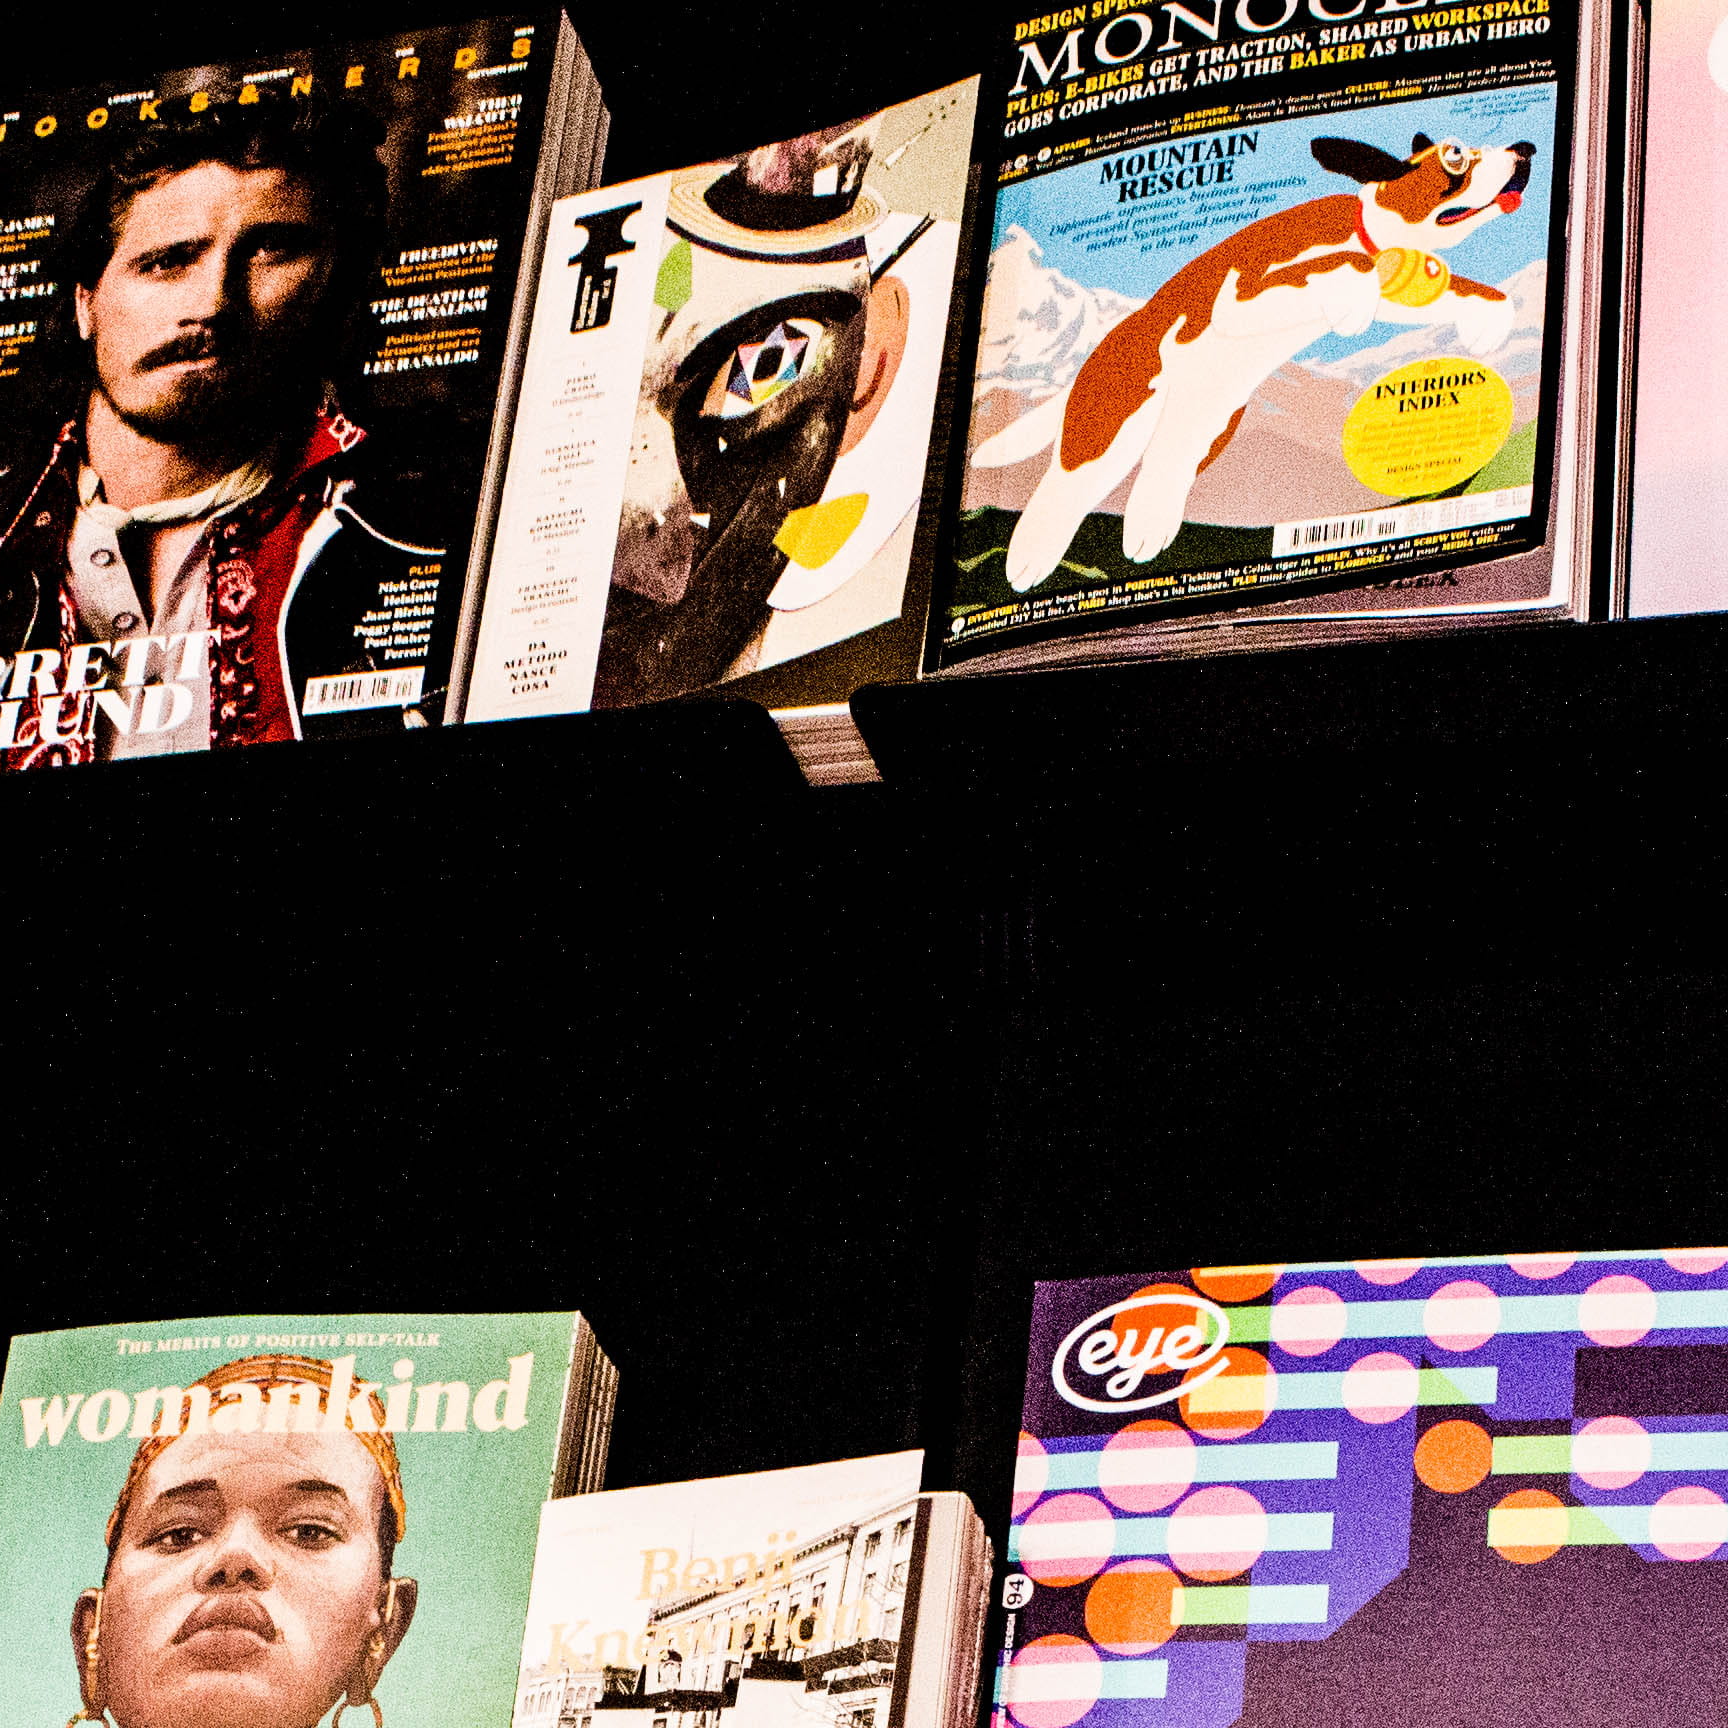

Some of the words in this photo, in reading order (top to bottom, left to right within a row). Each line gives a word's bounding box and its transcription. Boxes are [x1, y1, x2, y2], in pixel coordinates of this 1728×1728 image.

[1014, 4, 1088, 41] DESIGN
[1006, 91, 1060, 118] PLUS:
[1065, 63, 1145, 100] E-BIKES
[1149, 53, 1192, 77] GET
[1195, 30, 1312, 67] TRACTION,
[1318, 17, 1409, 47] SHARED
[1411, 0, 1551, 32] WORKSPACE
[1004, 108, 1055, 139] GOES
[1058, 77, 1188, 121] CORPORATE,
[1193, 63, 1238, 88] AND
[1241, 56, 1285, 79] THE
[1289, 42, 1366, 71] BAKER
[1370, 39, 1398, 59] AS
[1403, 24, 1482, 53] URBAN
[1486, 15, 1551, 42] HERO
[1100, 131, 1260, 185] MOUNTAIN
[1117, 158, 1235, 204] RESCUE
[1375, 370, 1487, 400] INTERIORS
[1399, 391, 1461, 413] INDEX
[1450, 529, 1471, 543] YOU
[409, 564, 442, 577] PLUS
[378, 580, 408, 595] Nick
[409, 577, 440, 592] Cave
[362, 610, 393, 623] Jane
[353, 623, 390, 638] Peggy
[364, 633, 393, 649] Paul
[503, 649, 568, 670] METODO
[509, 663, 557, 682] NASCE
[512, 679, 550, 695] COSA
[225, 1333, 251, 1348] OF
[254, 1333, 341, 1349] POSITIVE
[344, 1332, 441, 1348] SELF-TALK
[1079, 1319, 1206, 1399] eye
[19, 1351, 536, 1450] womankind
[635, 1529, 798, 1604] Benji
[1004, 1574, 1028, 1607] 94
